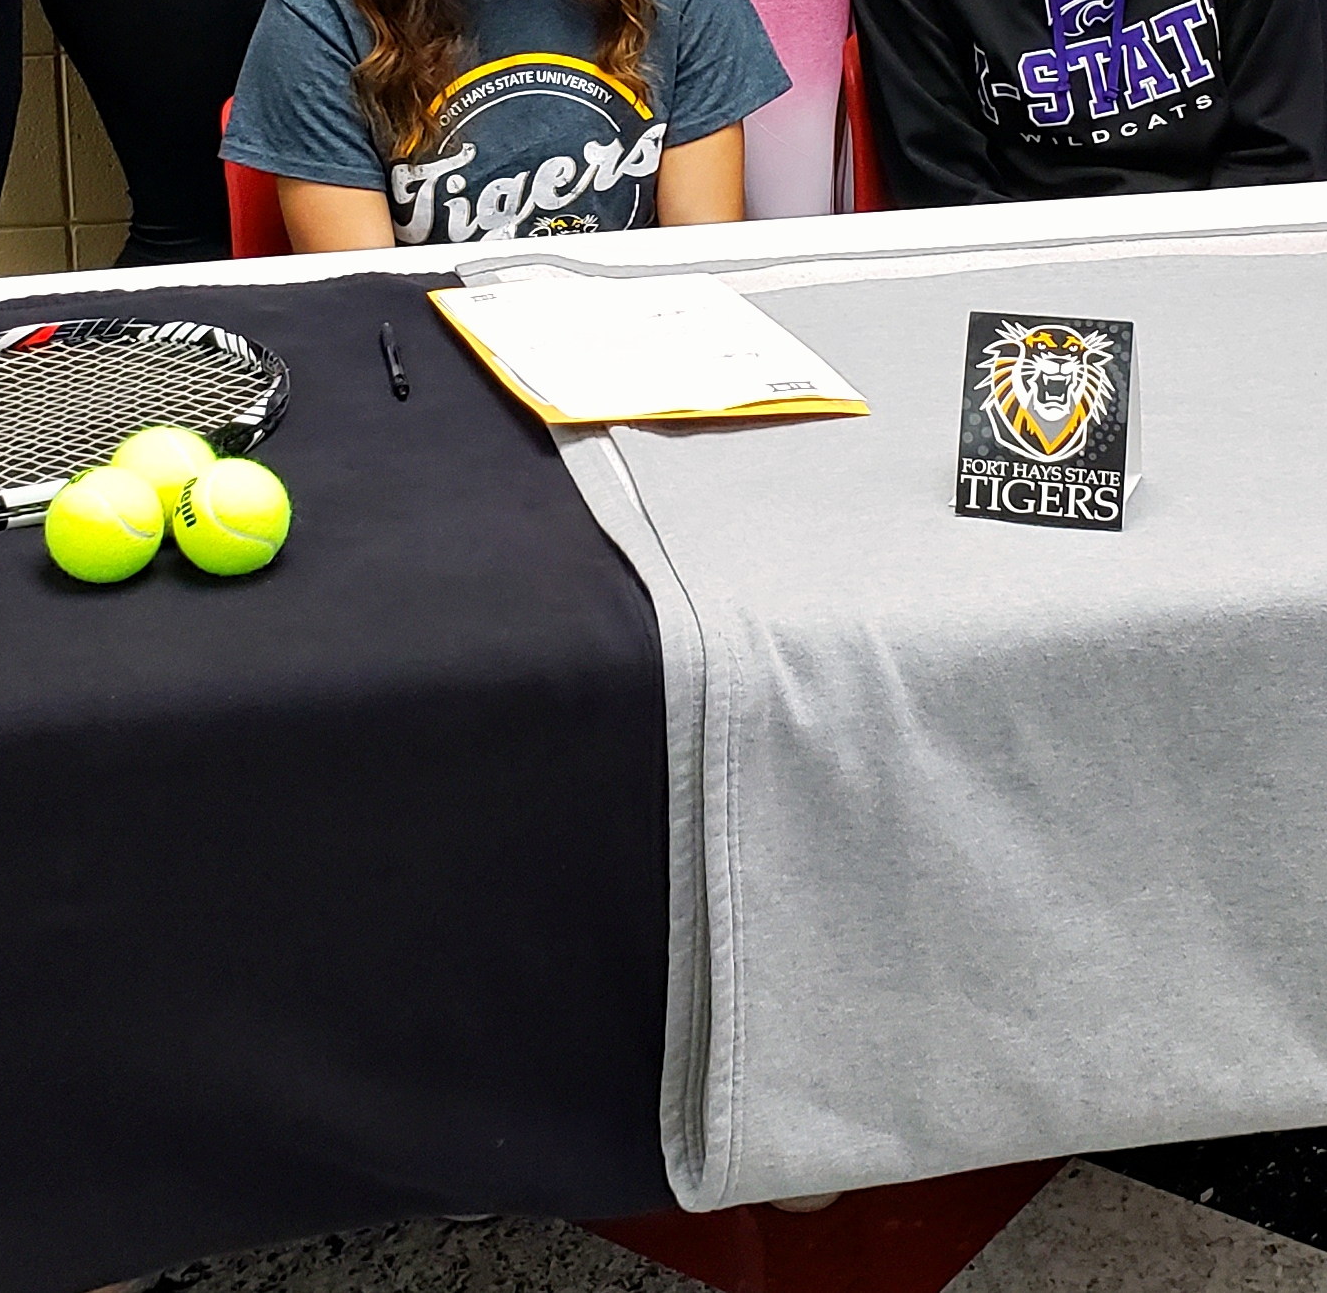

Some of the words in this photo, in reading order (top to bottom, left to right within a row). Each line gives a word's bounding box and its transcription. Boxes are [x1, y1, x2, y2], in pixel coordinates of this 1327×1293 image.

[462, 83, 496, 107] HAYS
[495, 70, 534, 91] STATE
[536, 70, 613, 105] UNIVERSITY
[1019, 94, 1213, 147] WILDCATS
[391, 122, 668, 244] Tigers
[961, 458, 1009, 477] FORT
[1012, 461, 1062, 482] HAYS
[1064, 466, 1121, 487] STATE
[960, 474, 1120, 522] TIGERS
